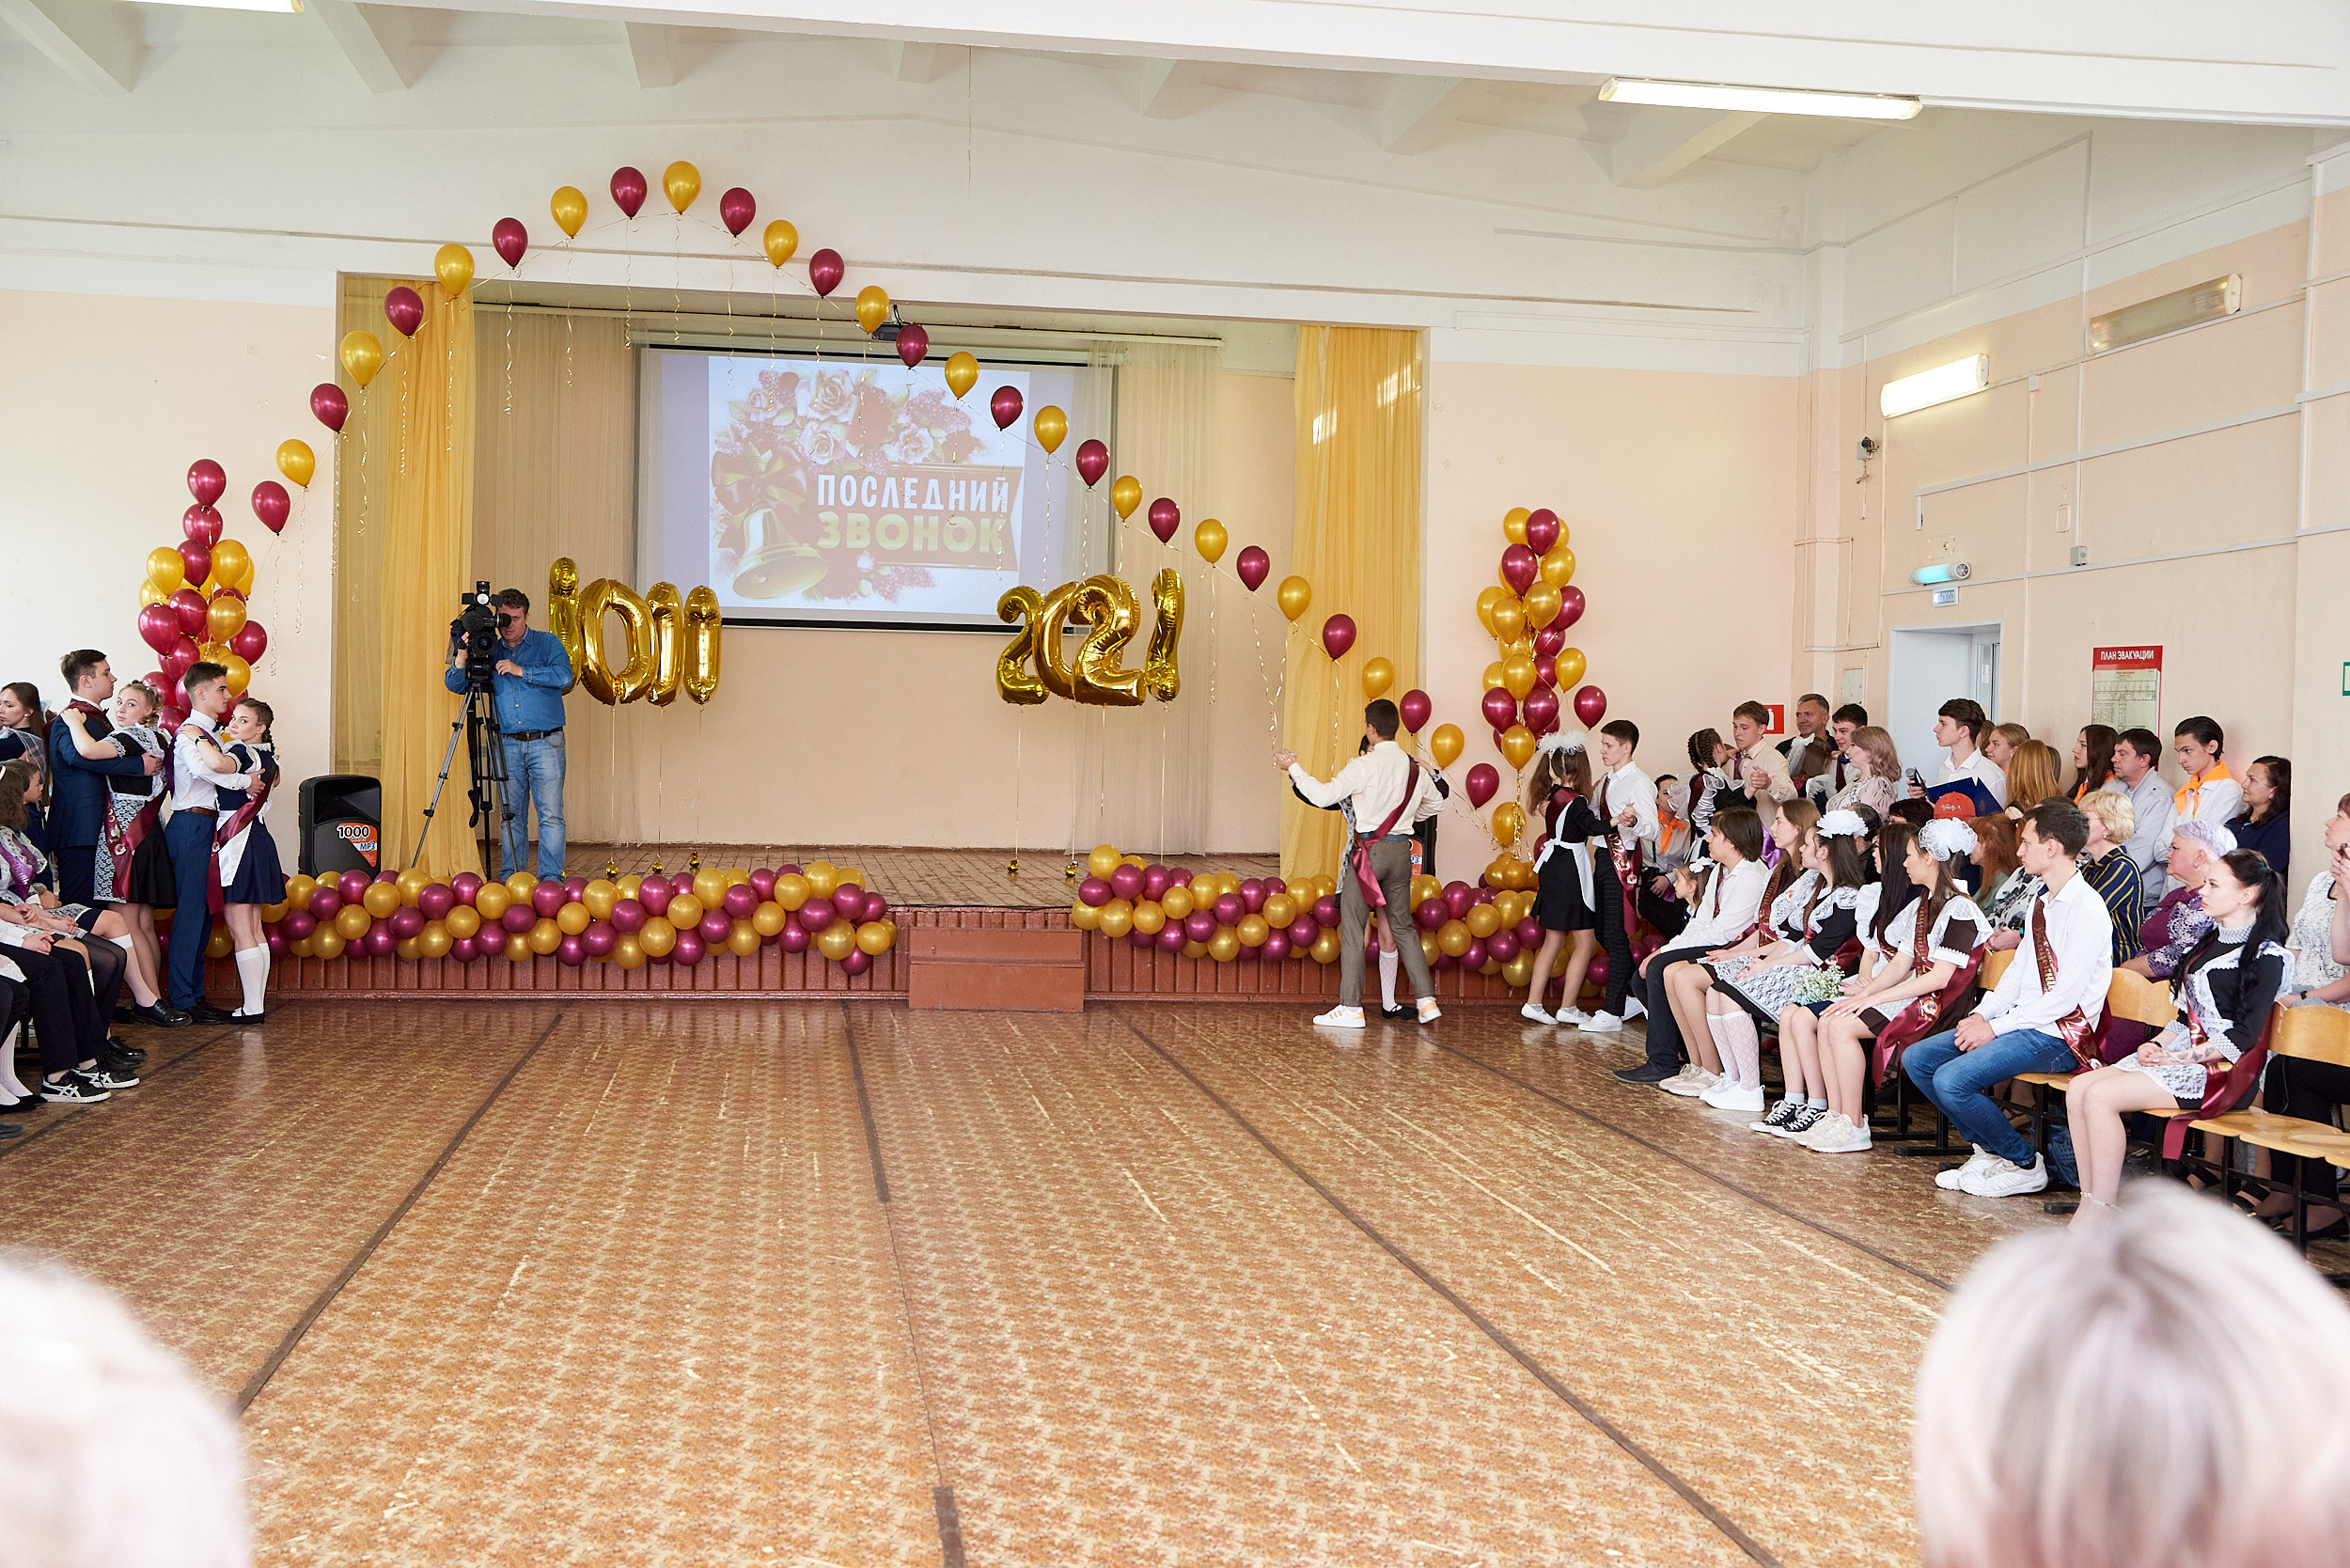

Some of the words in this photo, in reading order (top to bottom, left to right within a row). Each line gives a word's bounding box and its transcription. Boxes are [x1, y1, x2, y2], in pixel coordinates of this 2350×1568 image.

[817, 474, 1010, 513] ПОСЛЕДНИЙ
[817, 510, 1007, 554] ЗВОНОК
[2100, 651, 2117, 661] ПЛАН
[2117, 650, 2154, 661] ЭВАКУАЦИИ
[337, 825, 370, 839] 1000
[360, 841, 375, 851] MP3
